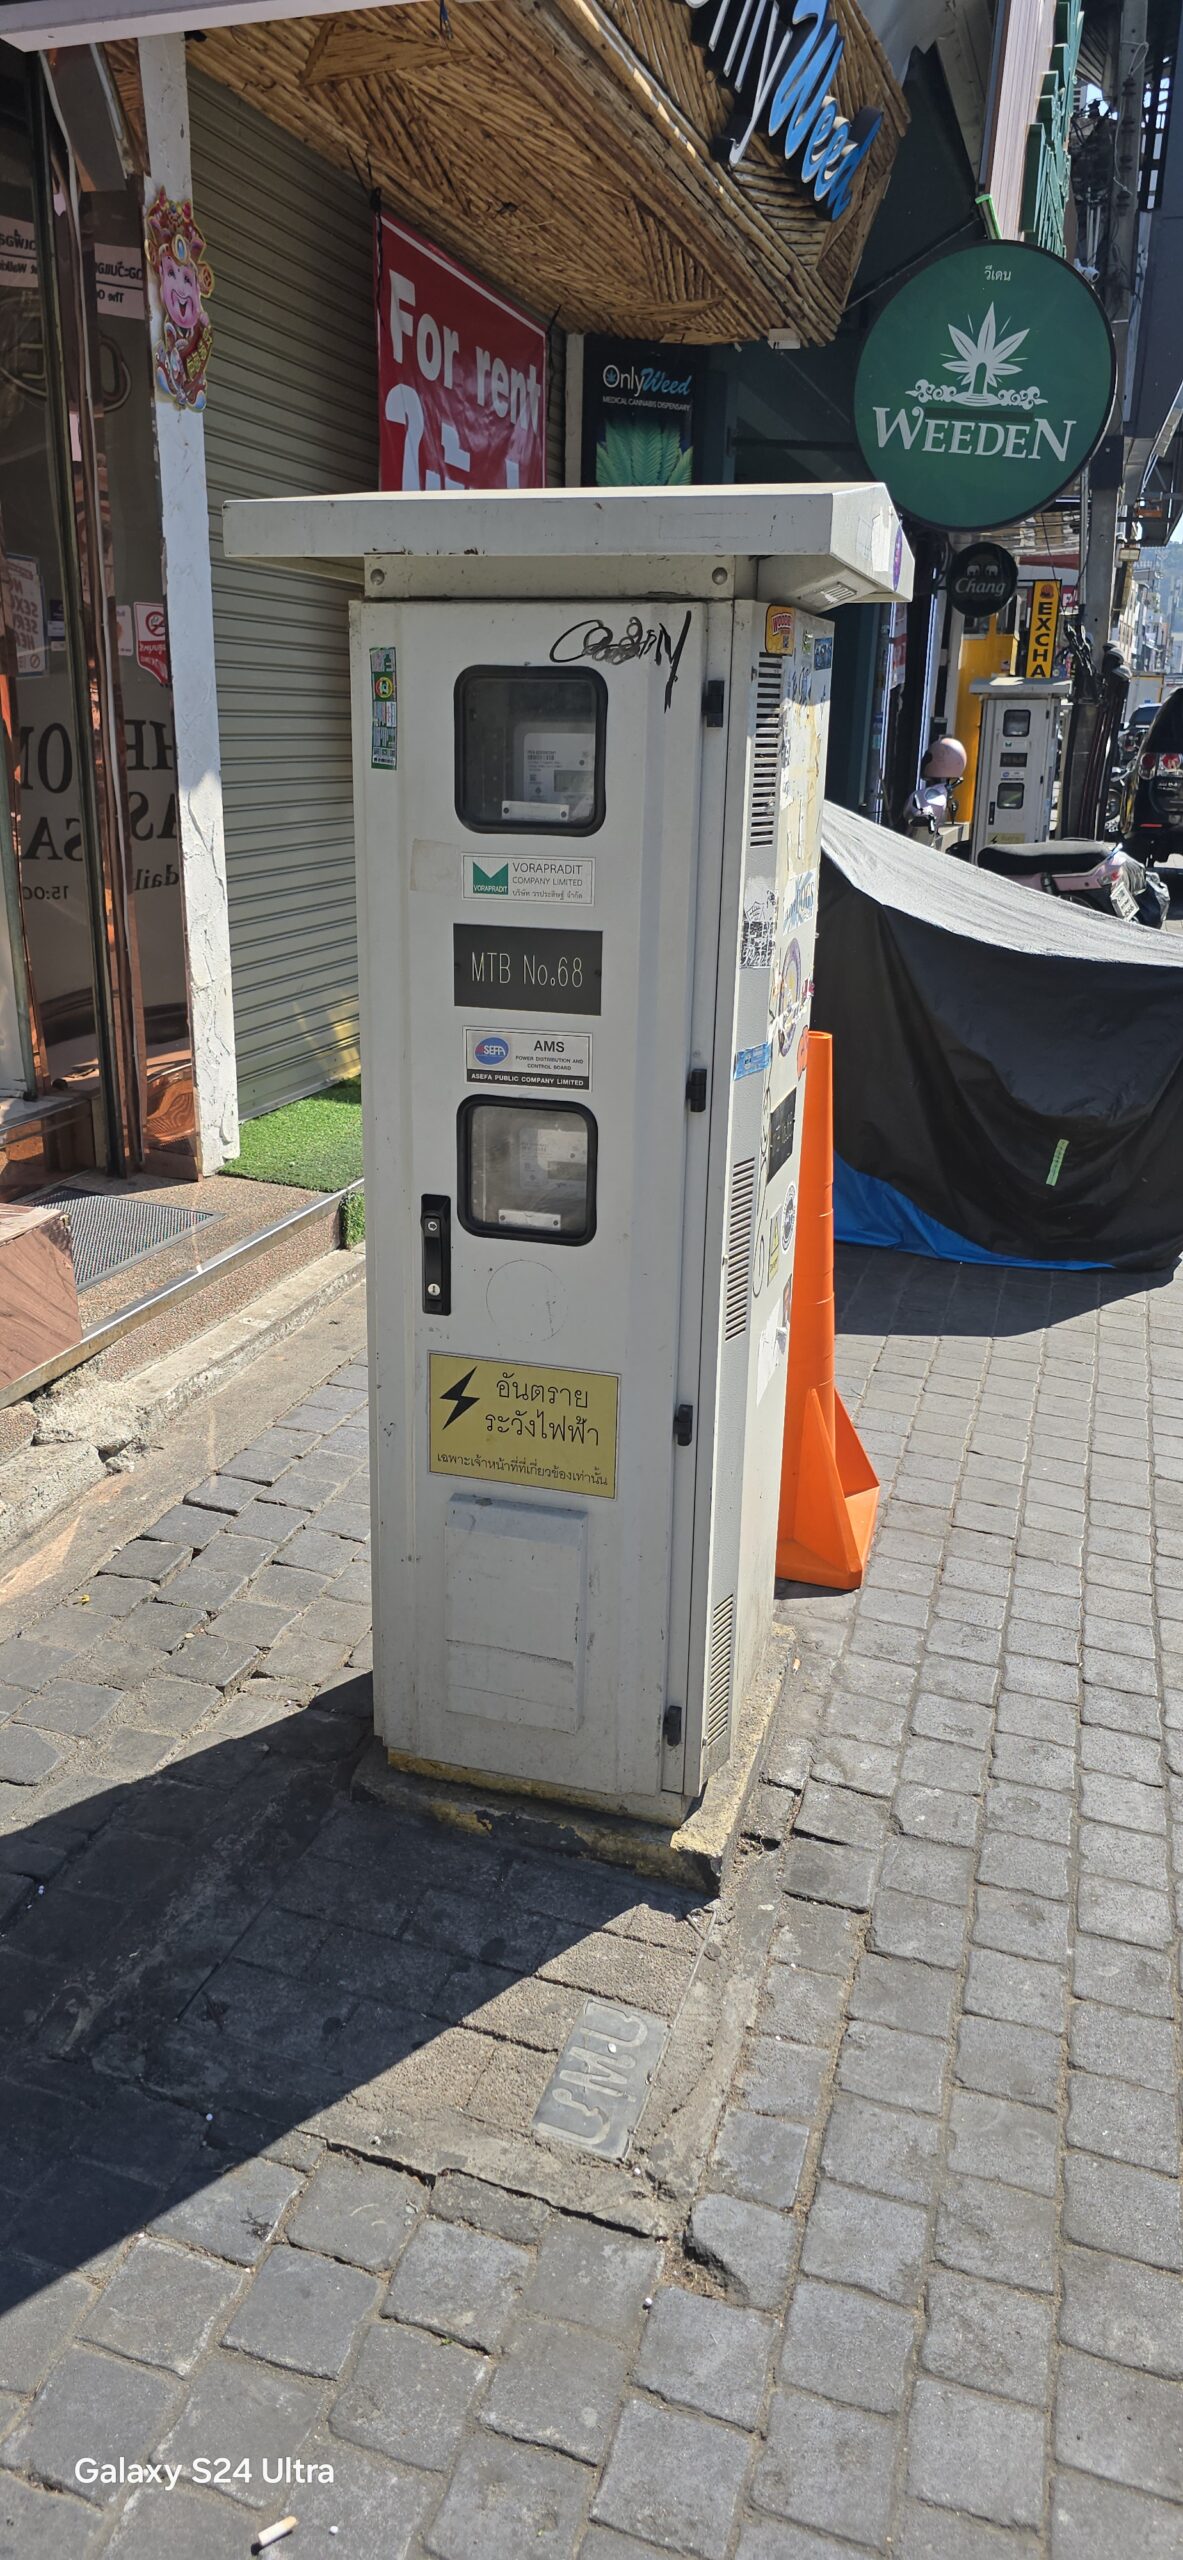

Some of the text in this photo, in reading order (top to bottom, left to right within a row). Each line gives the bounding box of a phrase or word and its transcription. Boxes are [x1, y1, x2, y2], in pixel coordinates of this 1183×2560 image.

[389, 269, 541, 434] For rent
[955, 577, 1007, 597] Chang
[512, 862, 583, 875] VORAPRADIT
[473, 884, 508, 893] VORAPRADIT
[512, 876, 583, 887] COMPANY LIMITED
[472, 951, 583, 988] MTB No.68
[533, 1040, 565, 1053] AMS
[494, 1074, 519, 1082] PUBLIC
[521, 1076, 554, 1084] COMPANY
[556, 1078, 584, 1086] LIMITED
[496, 1371, 589, 1409] อันตราย
[485, 1409, 599, 1446] ระวังไฟฟ้า
[437, 1452, 608, 1486] เฉพาะเจ้าหน้าที่ที่เกี่ยวข้องเท่านั้น
